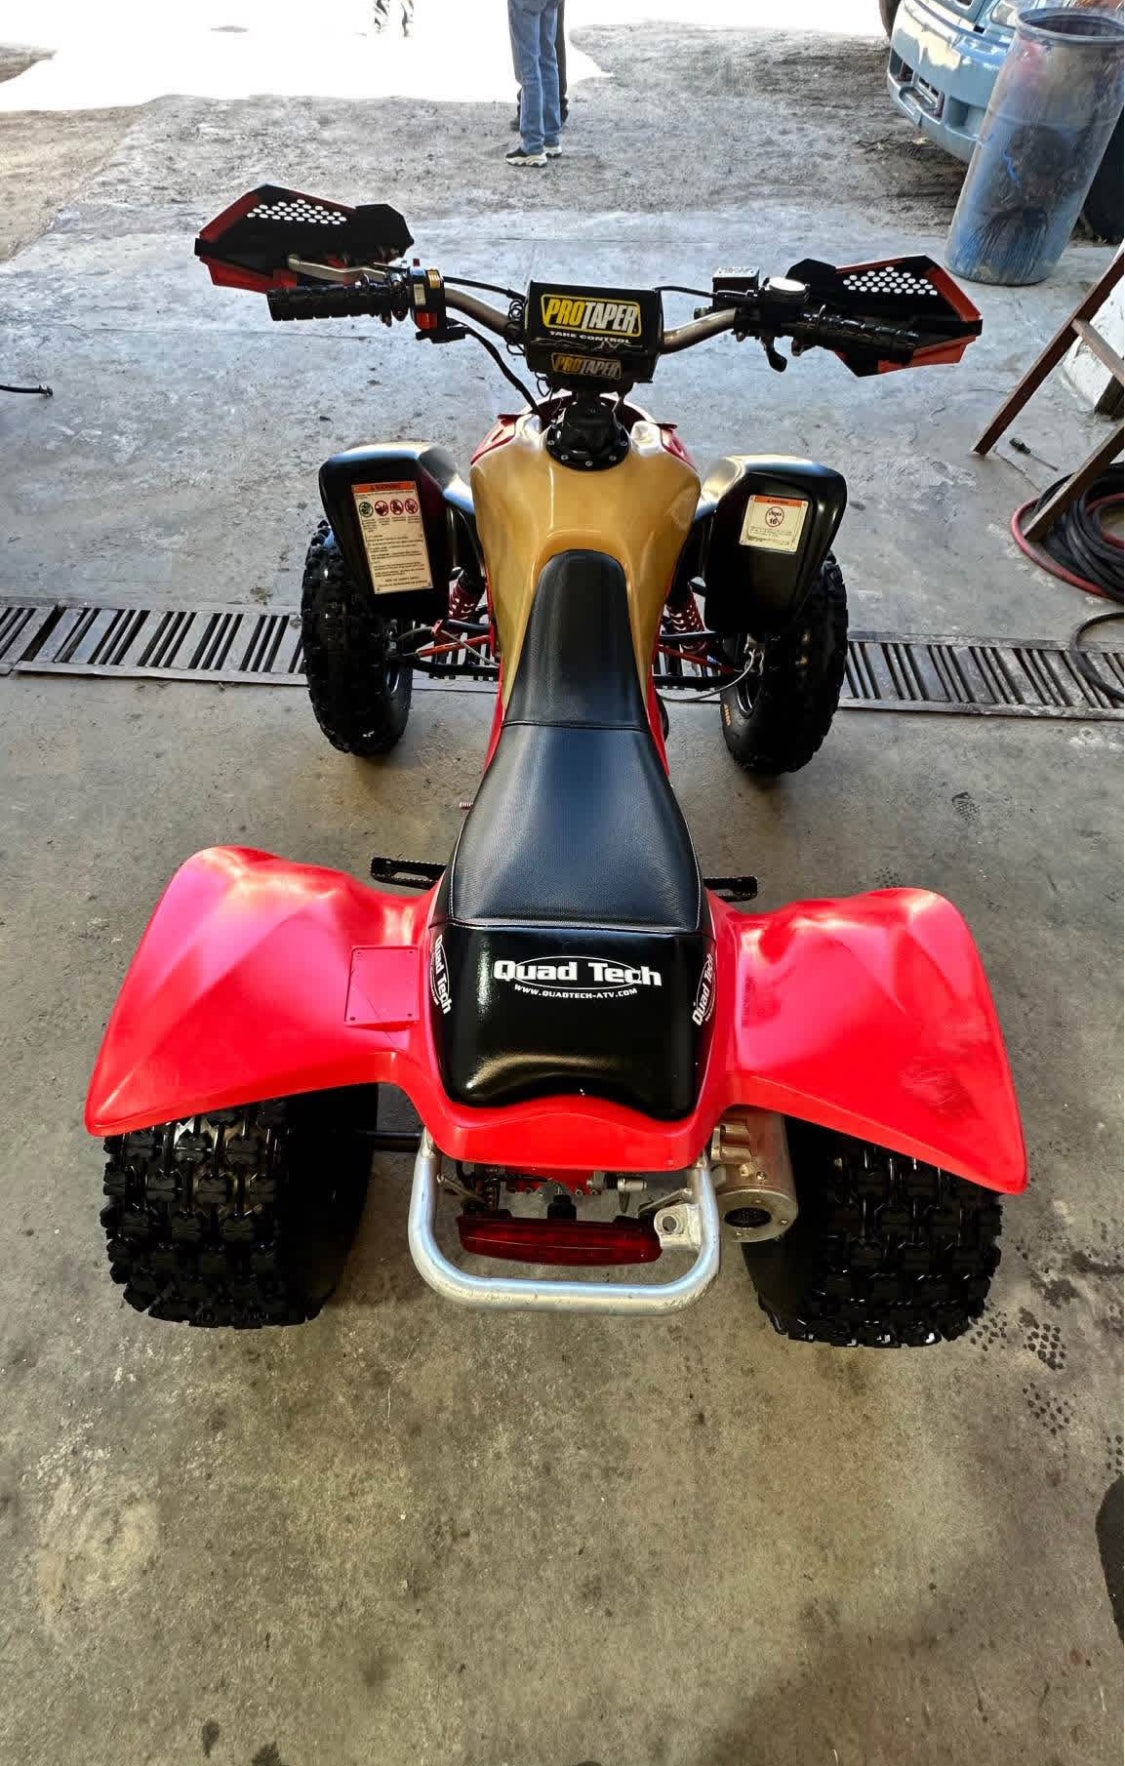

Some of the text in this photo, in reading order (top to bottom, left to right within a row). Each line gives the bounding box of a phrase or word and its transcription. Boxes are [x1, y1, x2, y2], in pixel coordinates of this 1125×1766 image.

[545, 299, 640, 334] PROTAPER
[549, 331, 631, 344] TAKE CONTROL
[555, 355, 620, 378] PROTAPER
[435, 934, 445, 975] Quad
[493, 960, 662, 986] Quad Tech
[437, 972, 453, 1015] Tech
[692, 983, 710, 1026] Quad
